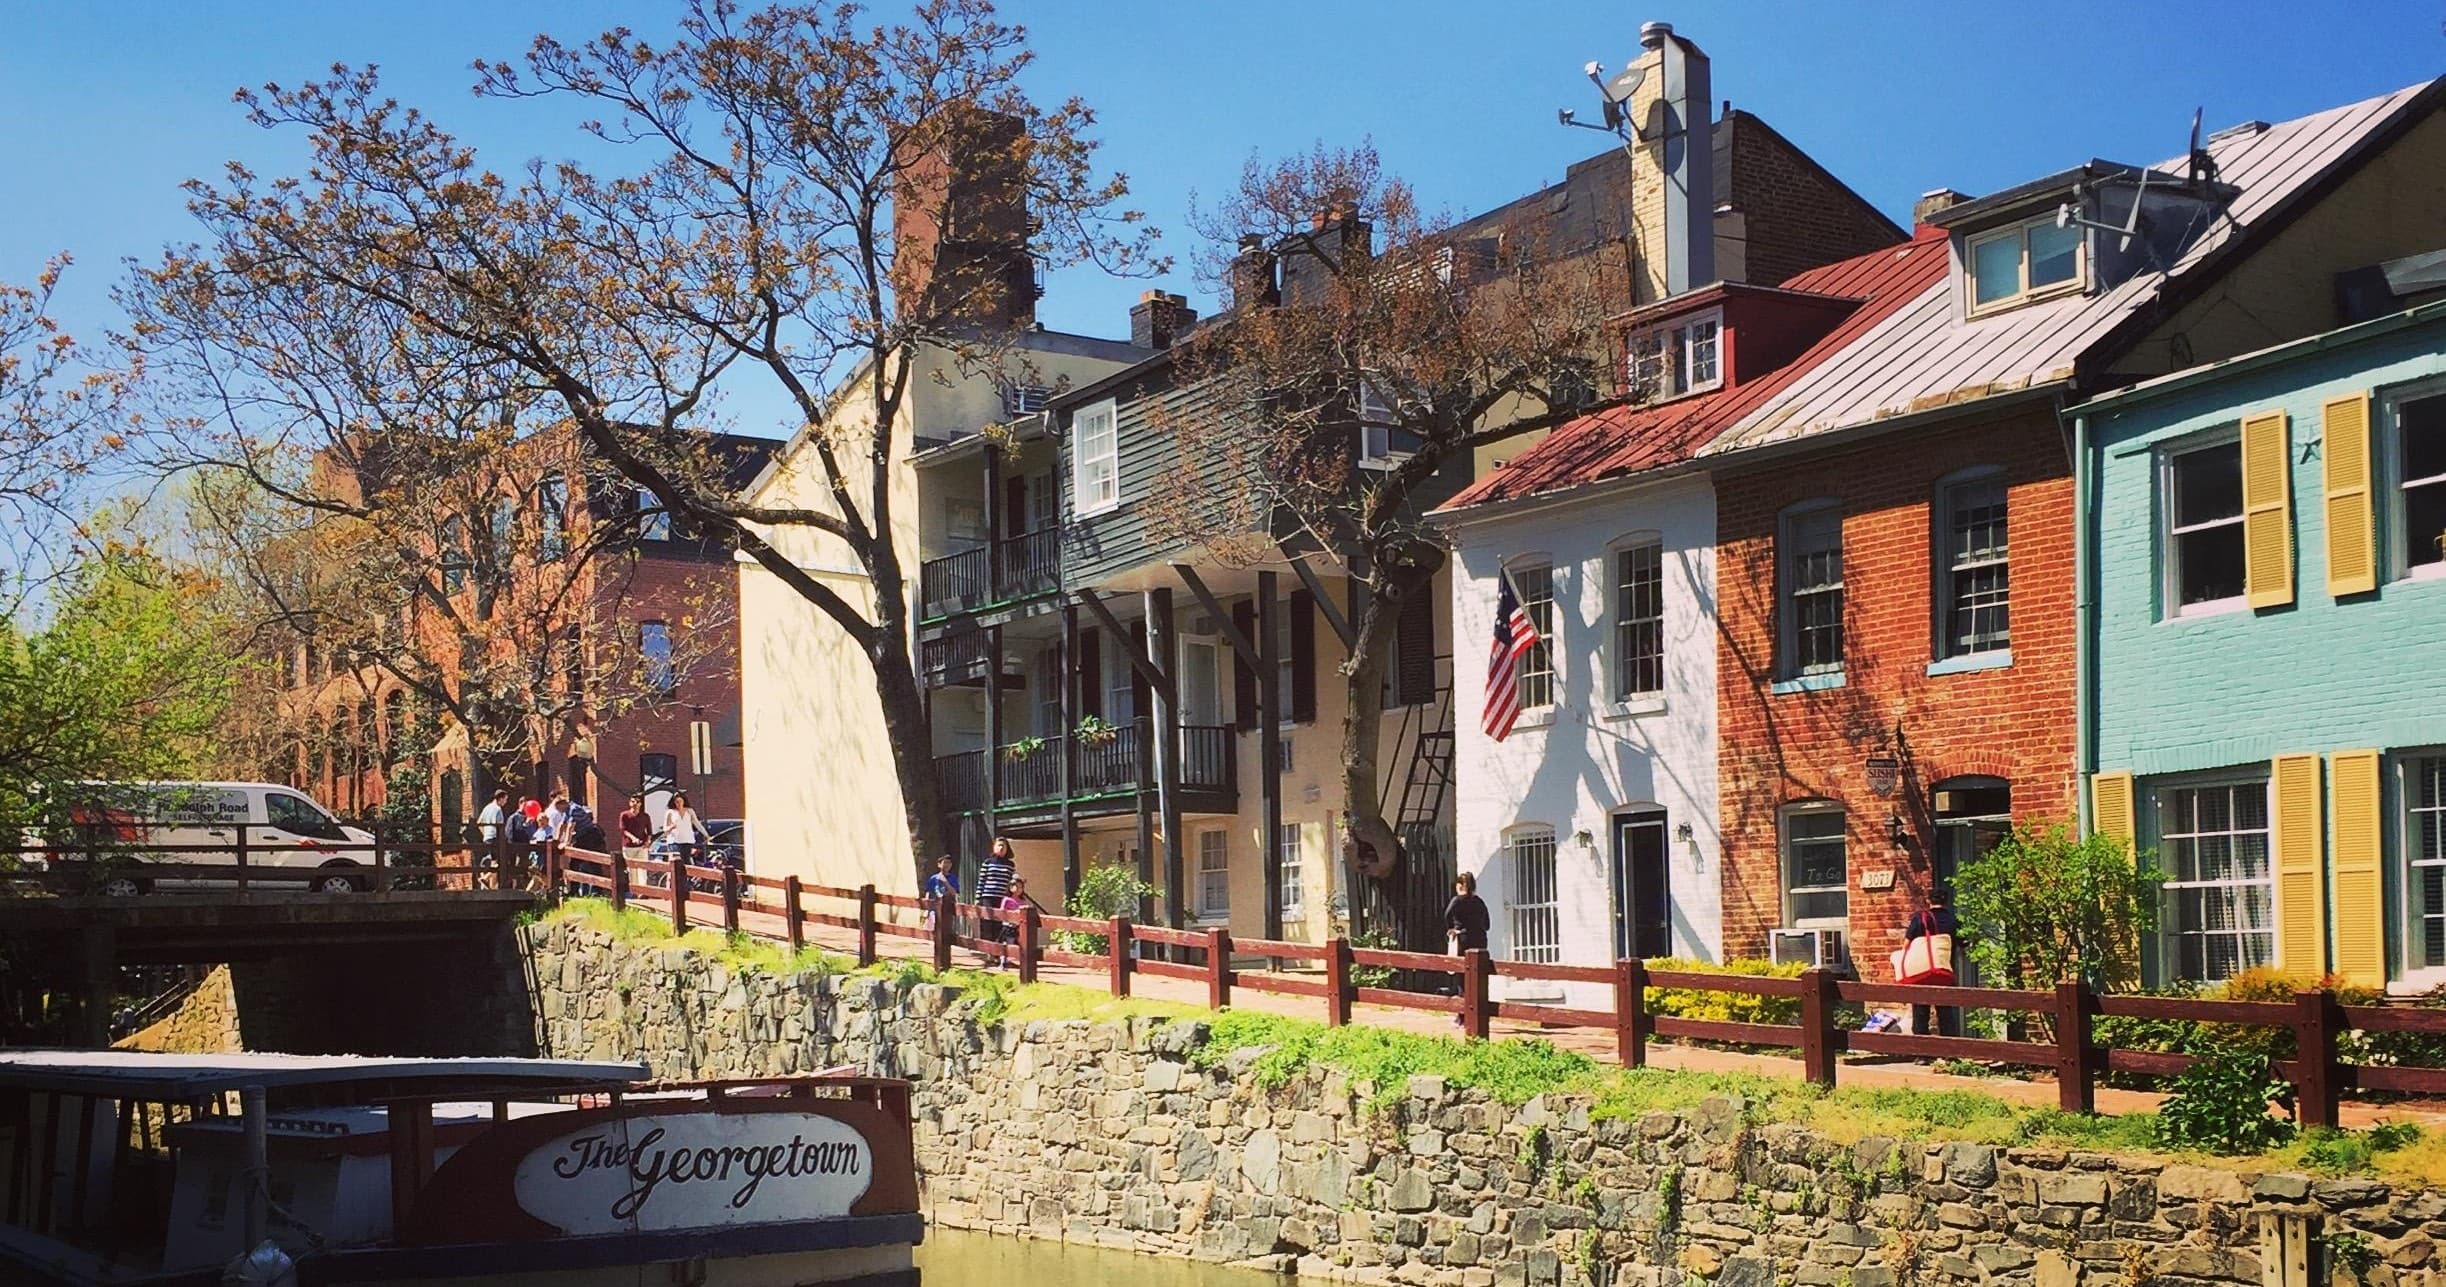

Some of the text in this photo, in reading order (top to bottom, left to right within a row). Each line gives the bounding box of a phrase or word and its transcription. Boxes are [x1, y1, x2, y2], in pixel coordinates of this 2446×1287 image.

[1868, 769, 1896, 778] SUSHI
[157, 801, 249, 813] Rdolph Road
[1825, 867, 1842, 881] Go
[553, 1128, 860, 1219] The Georgetown
